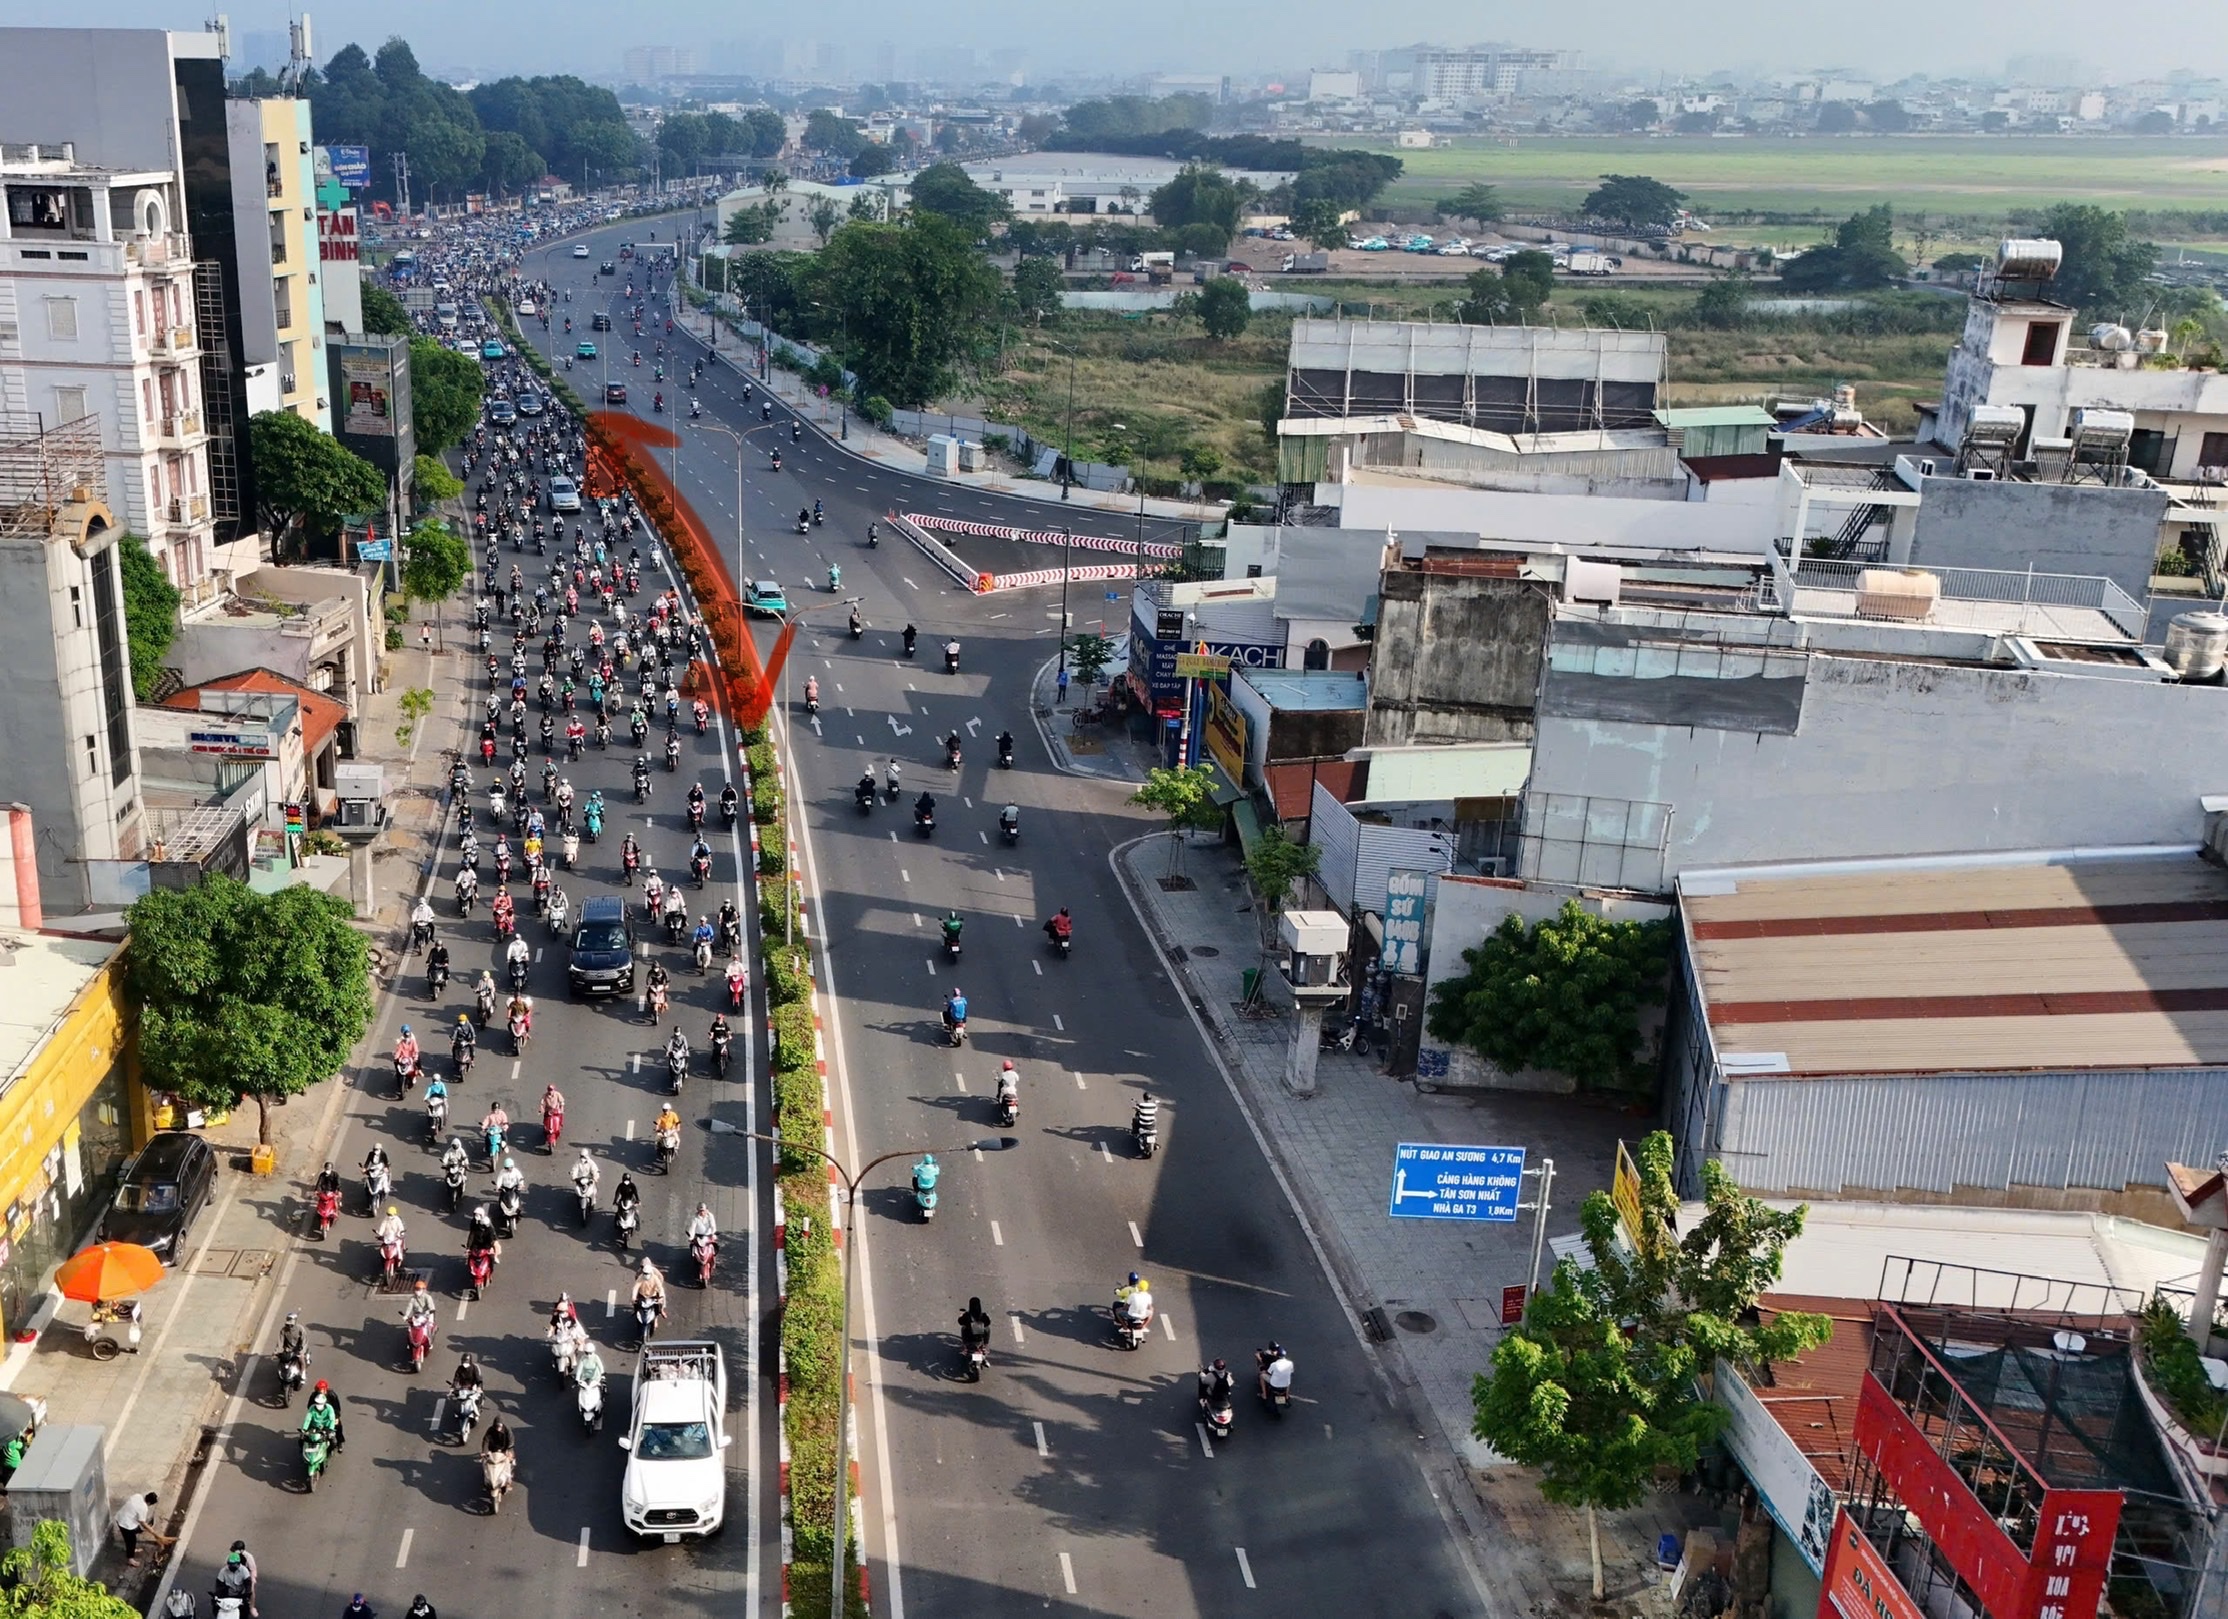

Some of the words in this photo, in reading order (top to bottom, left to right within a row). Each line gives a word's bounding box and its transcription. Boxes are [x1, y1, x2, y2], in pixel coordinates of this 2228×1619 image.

[1391, 897, 1415, 917] SỨ
[1400, 1147, 1417, 1159] NÚT
[1420, 1150, 1440, 1160] GIAO
[1441, 1151, 1454, 1161] AN
[1455, 1151, 1485, 1162] SƯƠNG
[1491, 1153, 1504, 1164] 4,7
[1506, 1154, 1521, 1164] Km
[1437, 1172, 1460, 1185] CẢNG
[1461, 1174, 1485, 1186] HÀNG
[1487, 1175, 1517, 1187] KHÔNG
[1440, 1187, 1456, 1199] TÂN
[1458, 1190, 1476, 1200] SƠN
[1478, 1187, 1501, 1201] NHẤT
[1433, 1201, 1450, 1214] NHÀ
[1452, 1204, 1464, 1214] GA
[1466, 1204, 1476, 1214] T3
